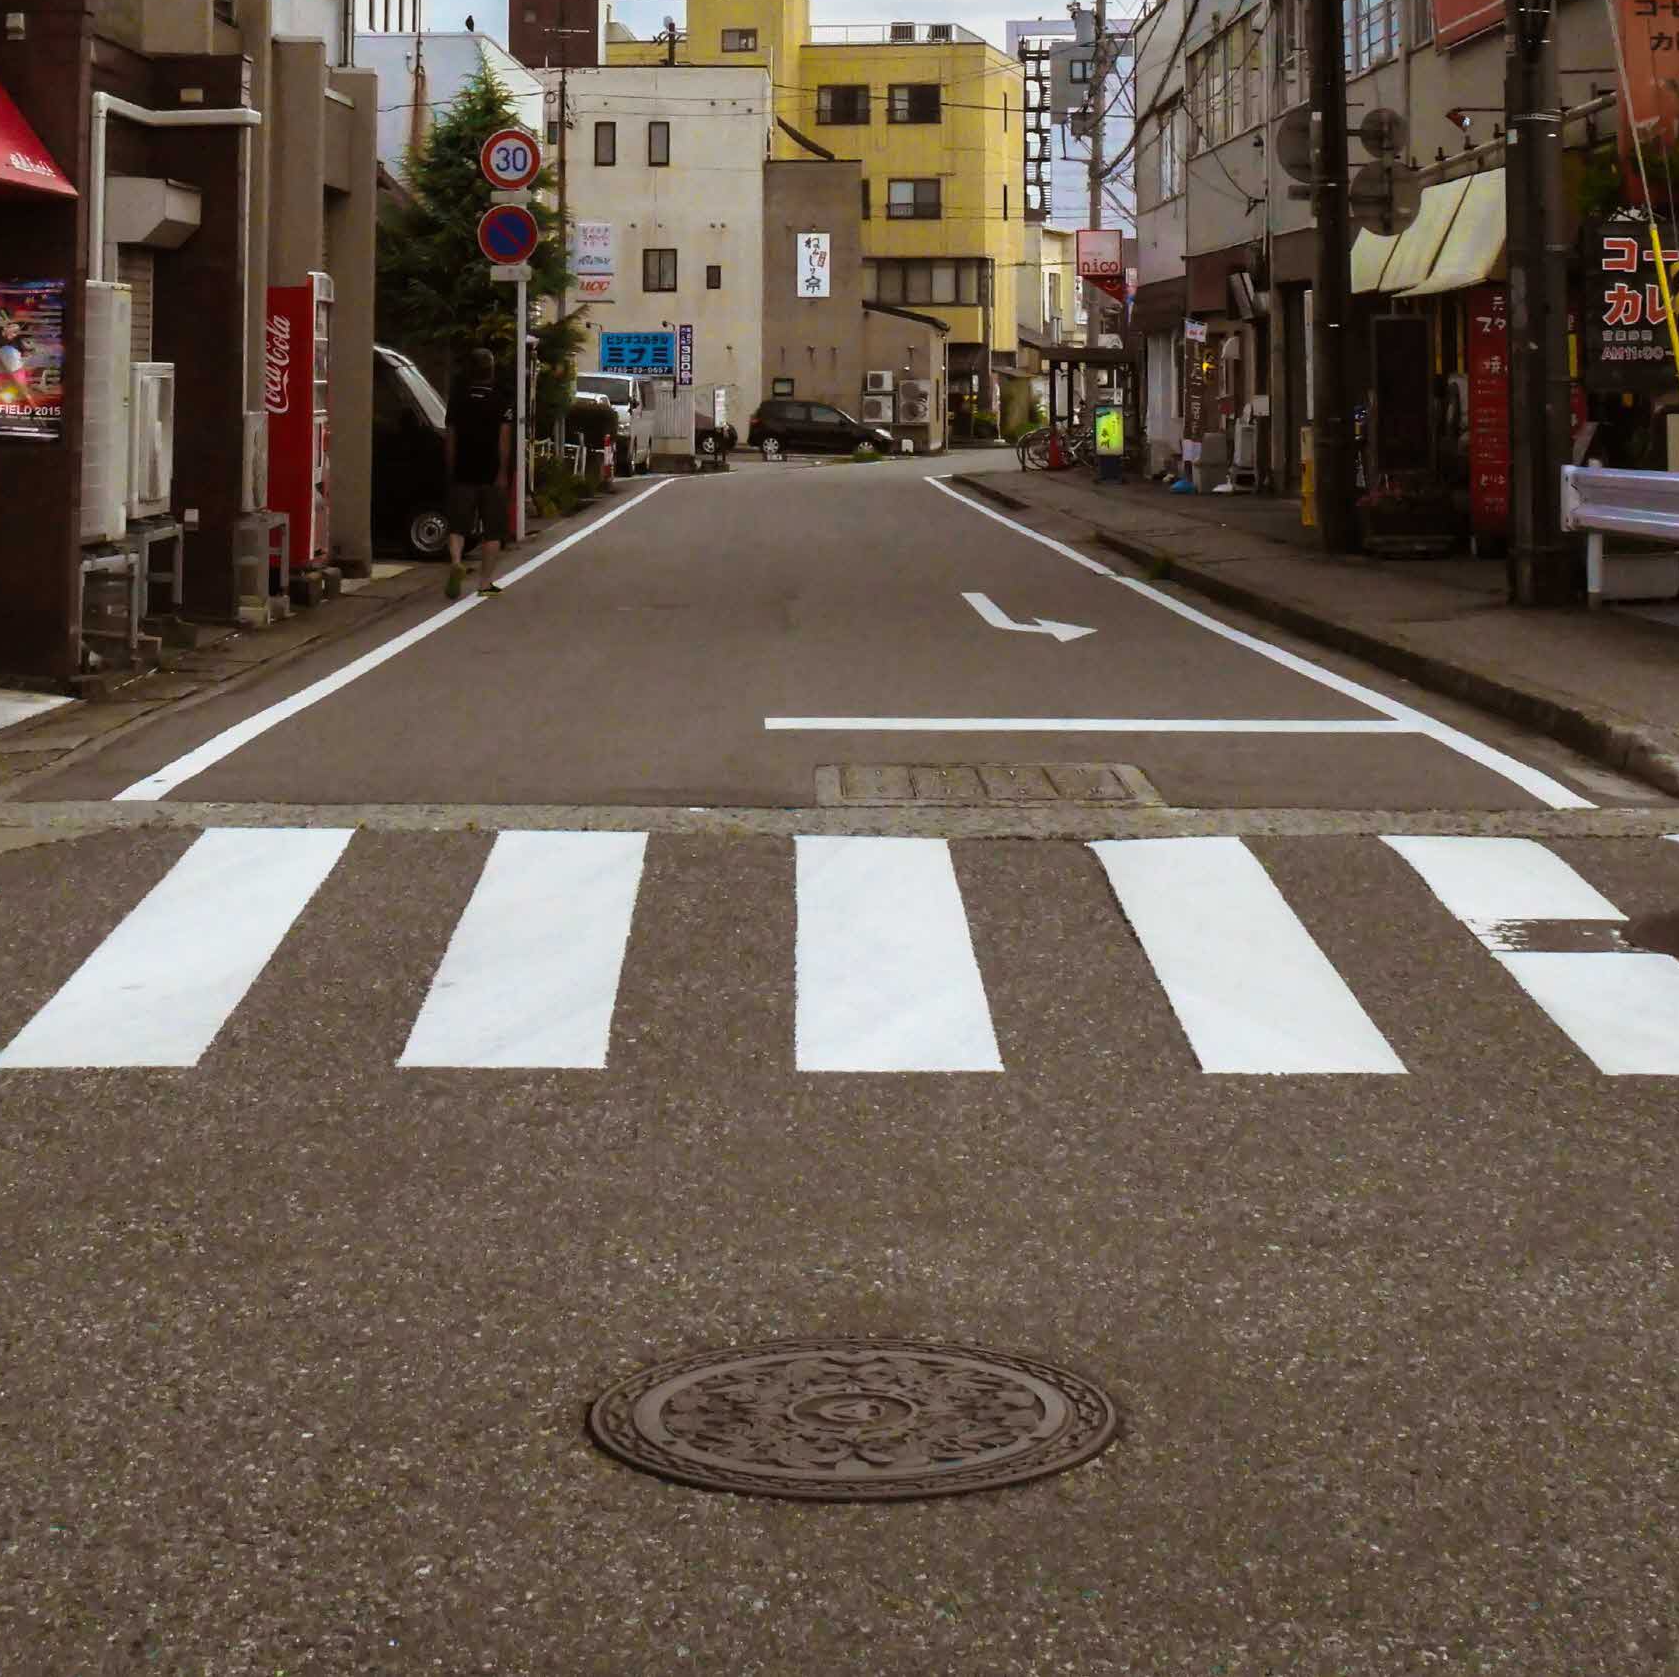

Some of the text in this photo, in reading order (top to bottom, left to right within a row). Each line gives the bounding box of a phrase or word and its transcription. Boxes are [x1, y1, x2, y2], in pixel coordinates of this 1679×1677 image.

[496, 147, 528, 172] 30
[1082, 259, 1119, 273] nico
[0, 404, 32, 415] FIELD
[35, 406, 61, 416] 2015
